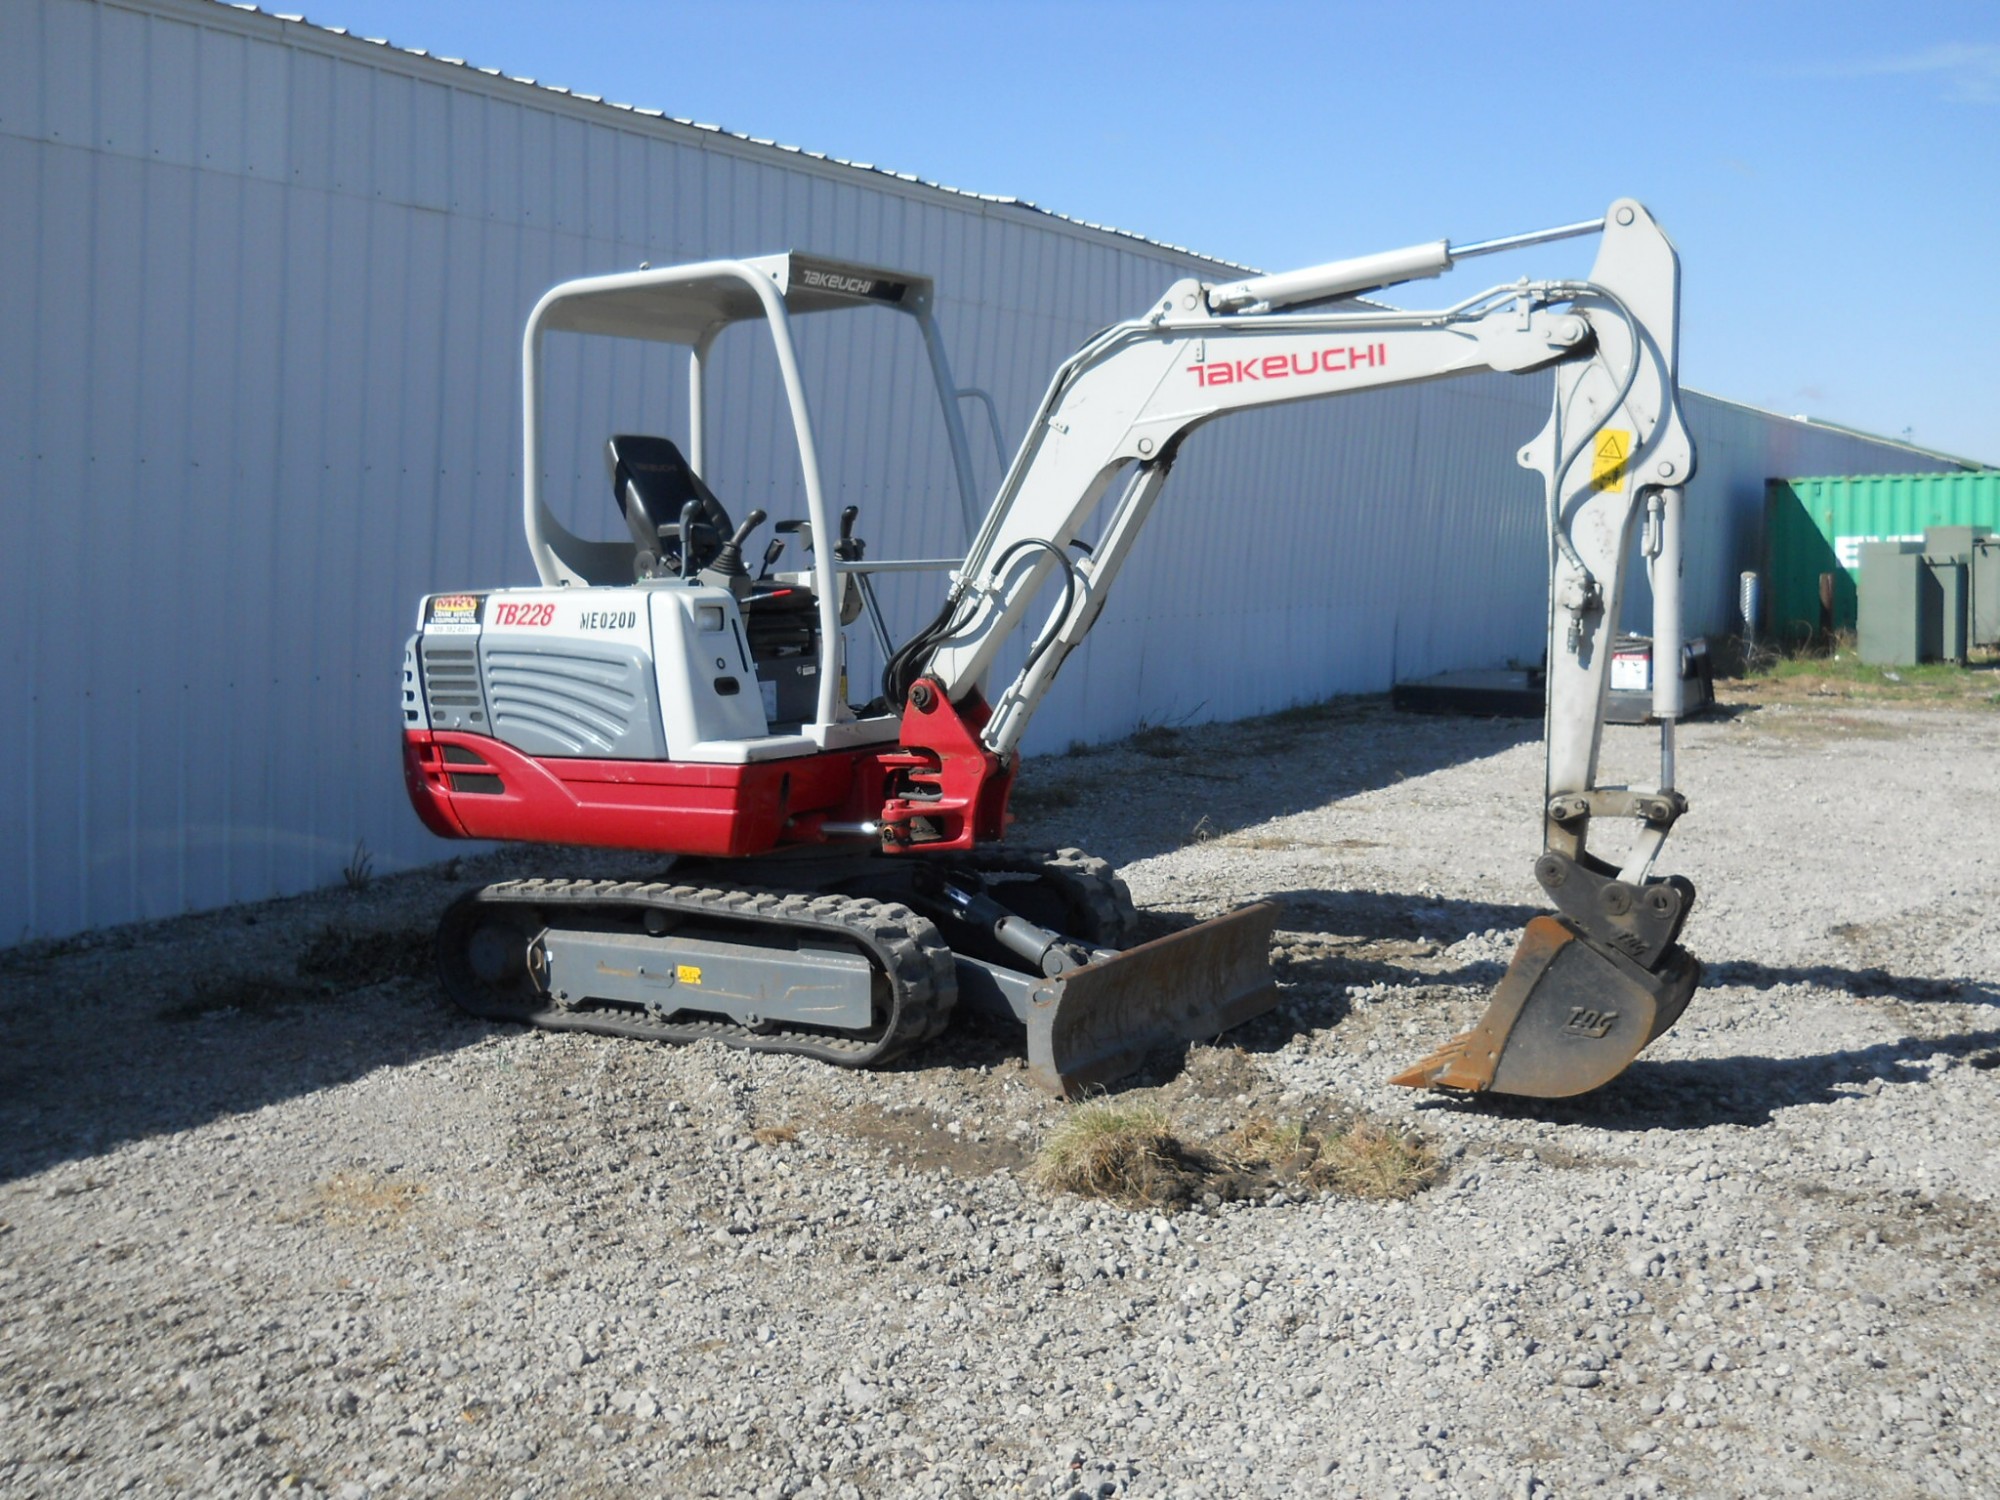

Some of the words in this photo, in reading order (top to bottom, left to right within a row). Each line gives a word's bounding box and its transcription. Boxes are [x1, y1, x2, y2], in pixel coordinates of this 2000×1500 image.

[802, 270, 872, 294] TAKEUCHI
[1186, 343, 1386, 387] TAKEUCHI
[495, 603, 555, 626] TB228
